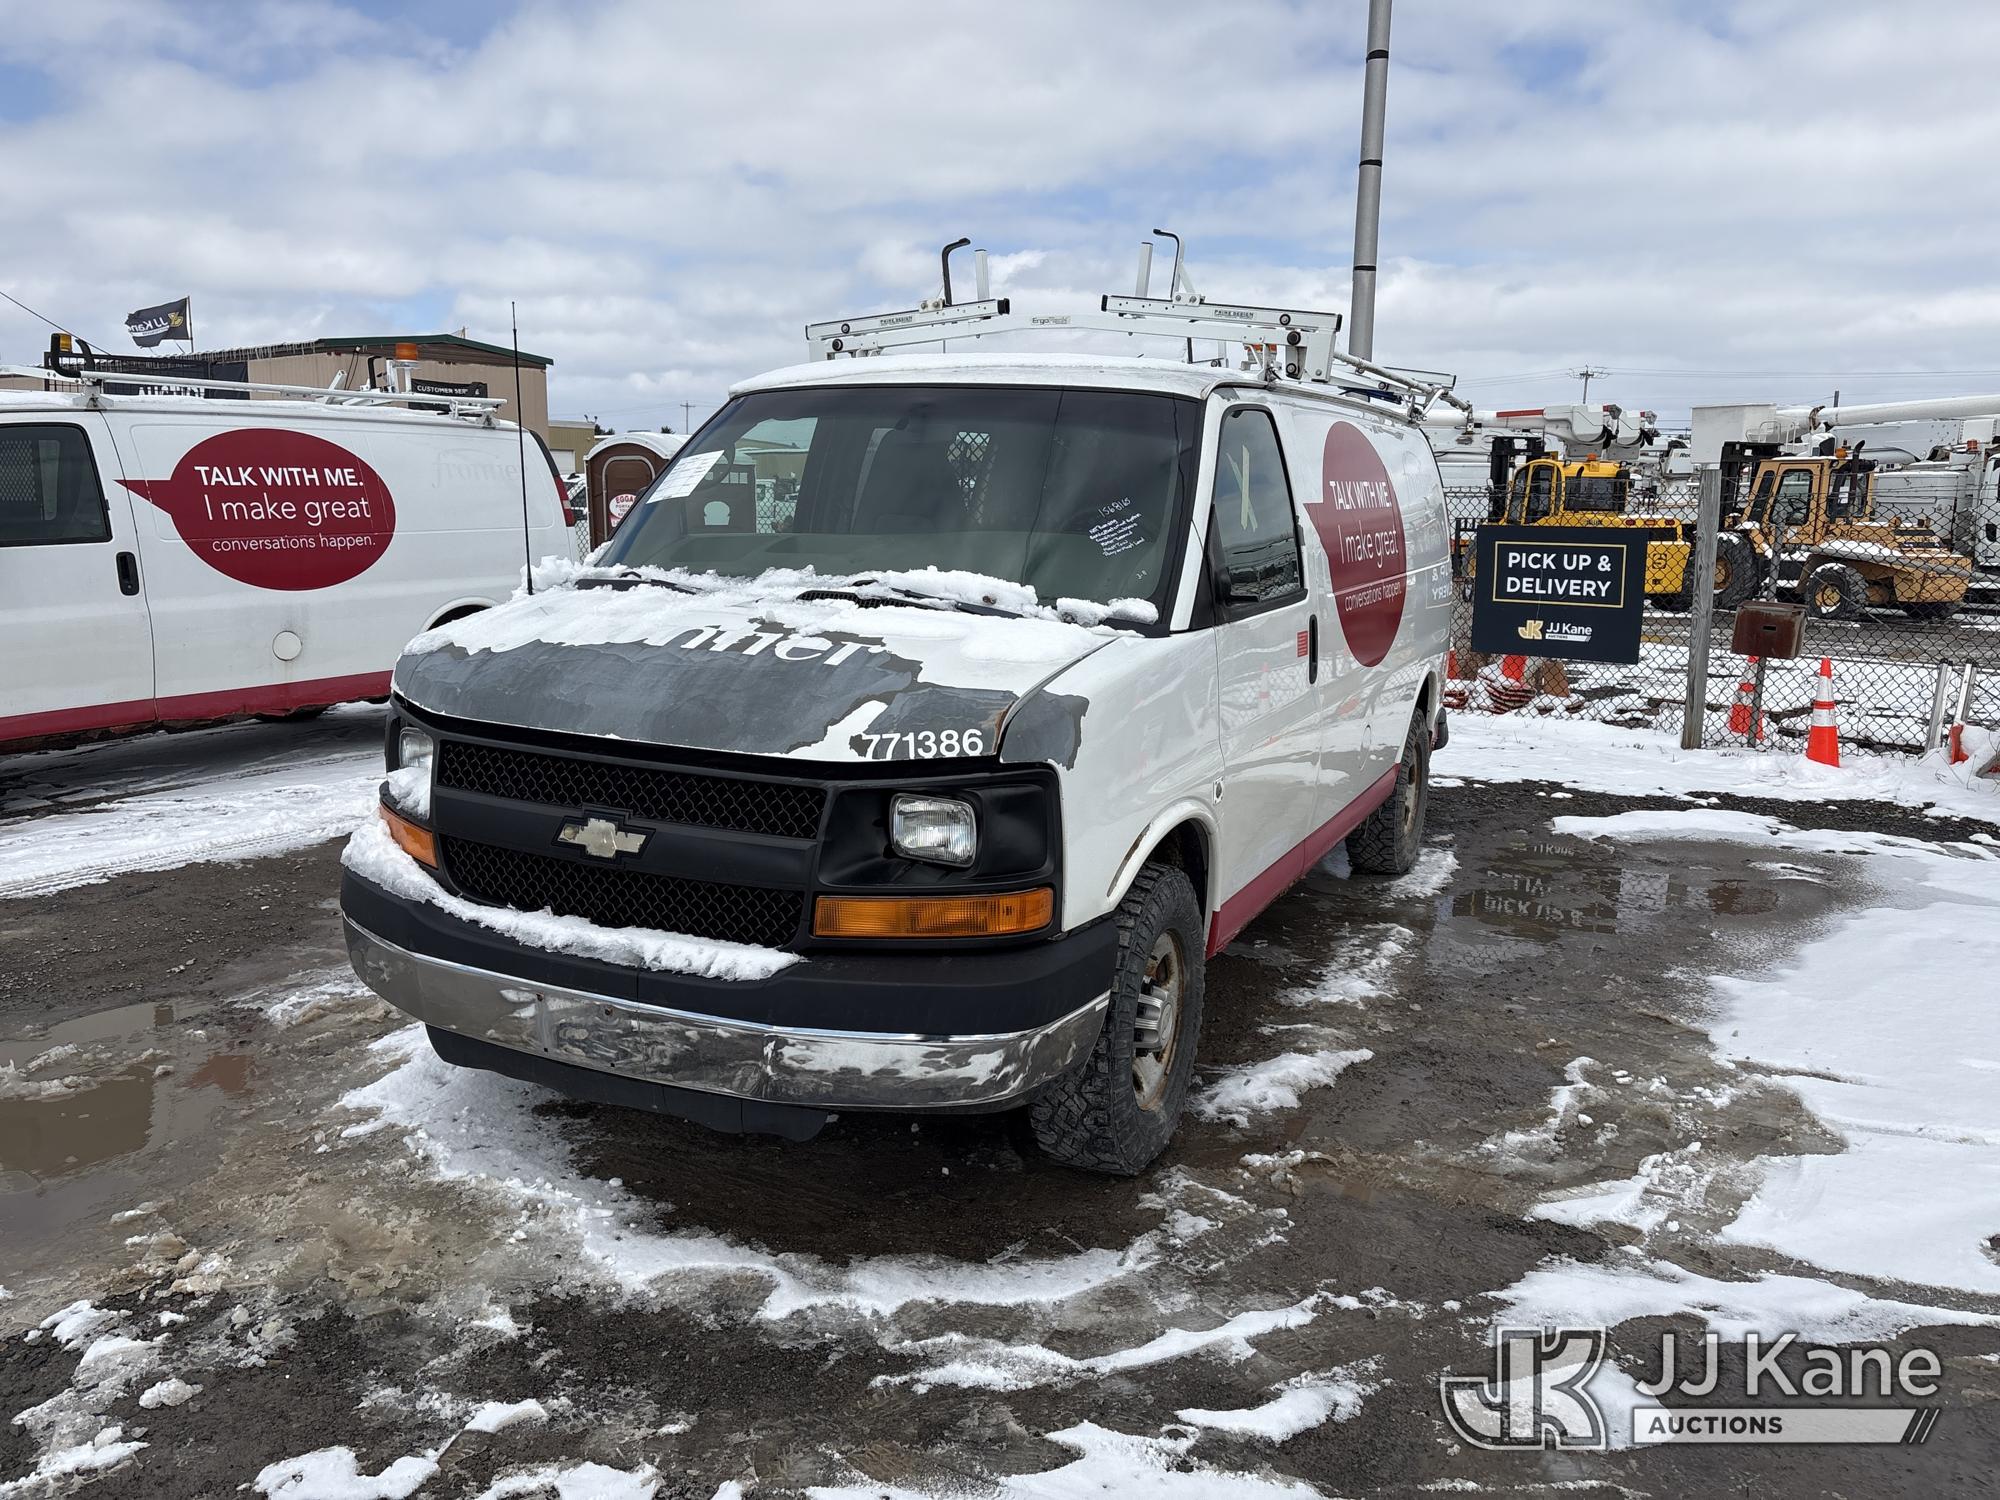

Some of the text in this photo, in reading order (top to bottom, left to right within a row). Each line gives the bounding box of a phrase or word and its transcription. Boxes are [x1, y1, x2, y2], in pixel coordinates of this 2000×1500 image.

[417, 385, 454, 394] CUSTOMER
[193, 466, 365, 487] TALK WITH ME.
[1329, 480, 1393, 510] TALK WITH ME.
[203, 492, 372, 527] I make great
[212, 532, 376, 552] conversations happen.
[1337, 519, 1399, 569] I make great
[1507, 552, 1612, 572] PICK UP &
[1506, 577, 1612, 597] DELIVERY
[1344, 587, 1382, 612] conversations
[1546, 622, 1560, 634] JJ
[1561, 622, 1593, 636] Kane
[861, 728, 984, 760] 771386
